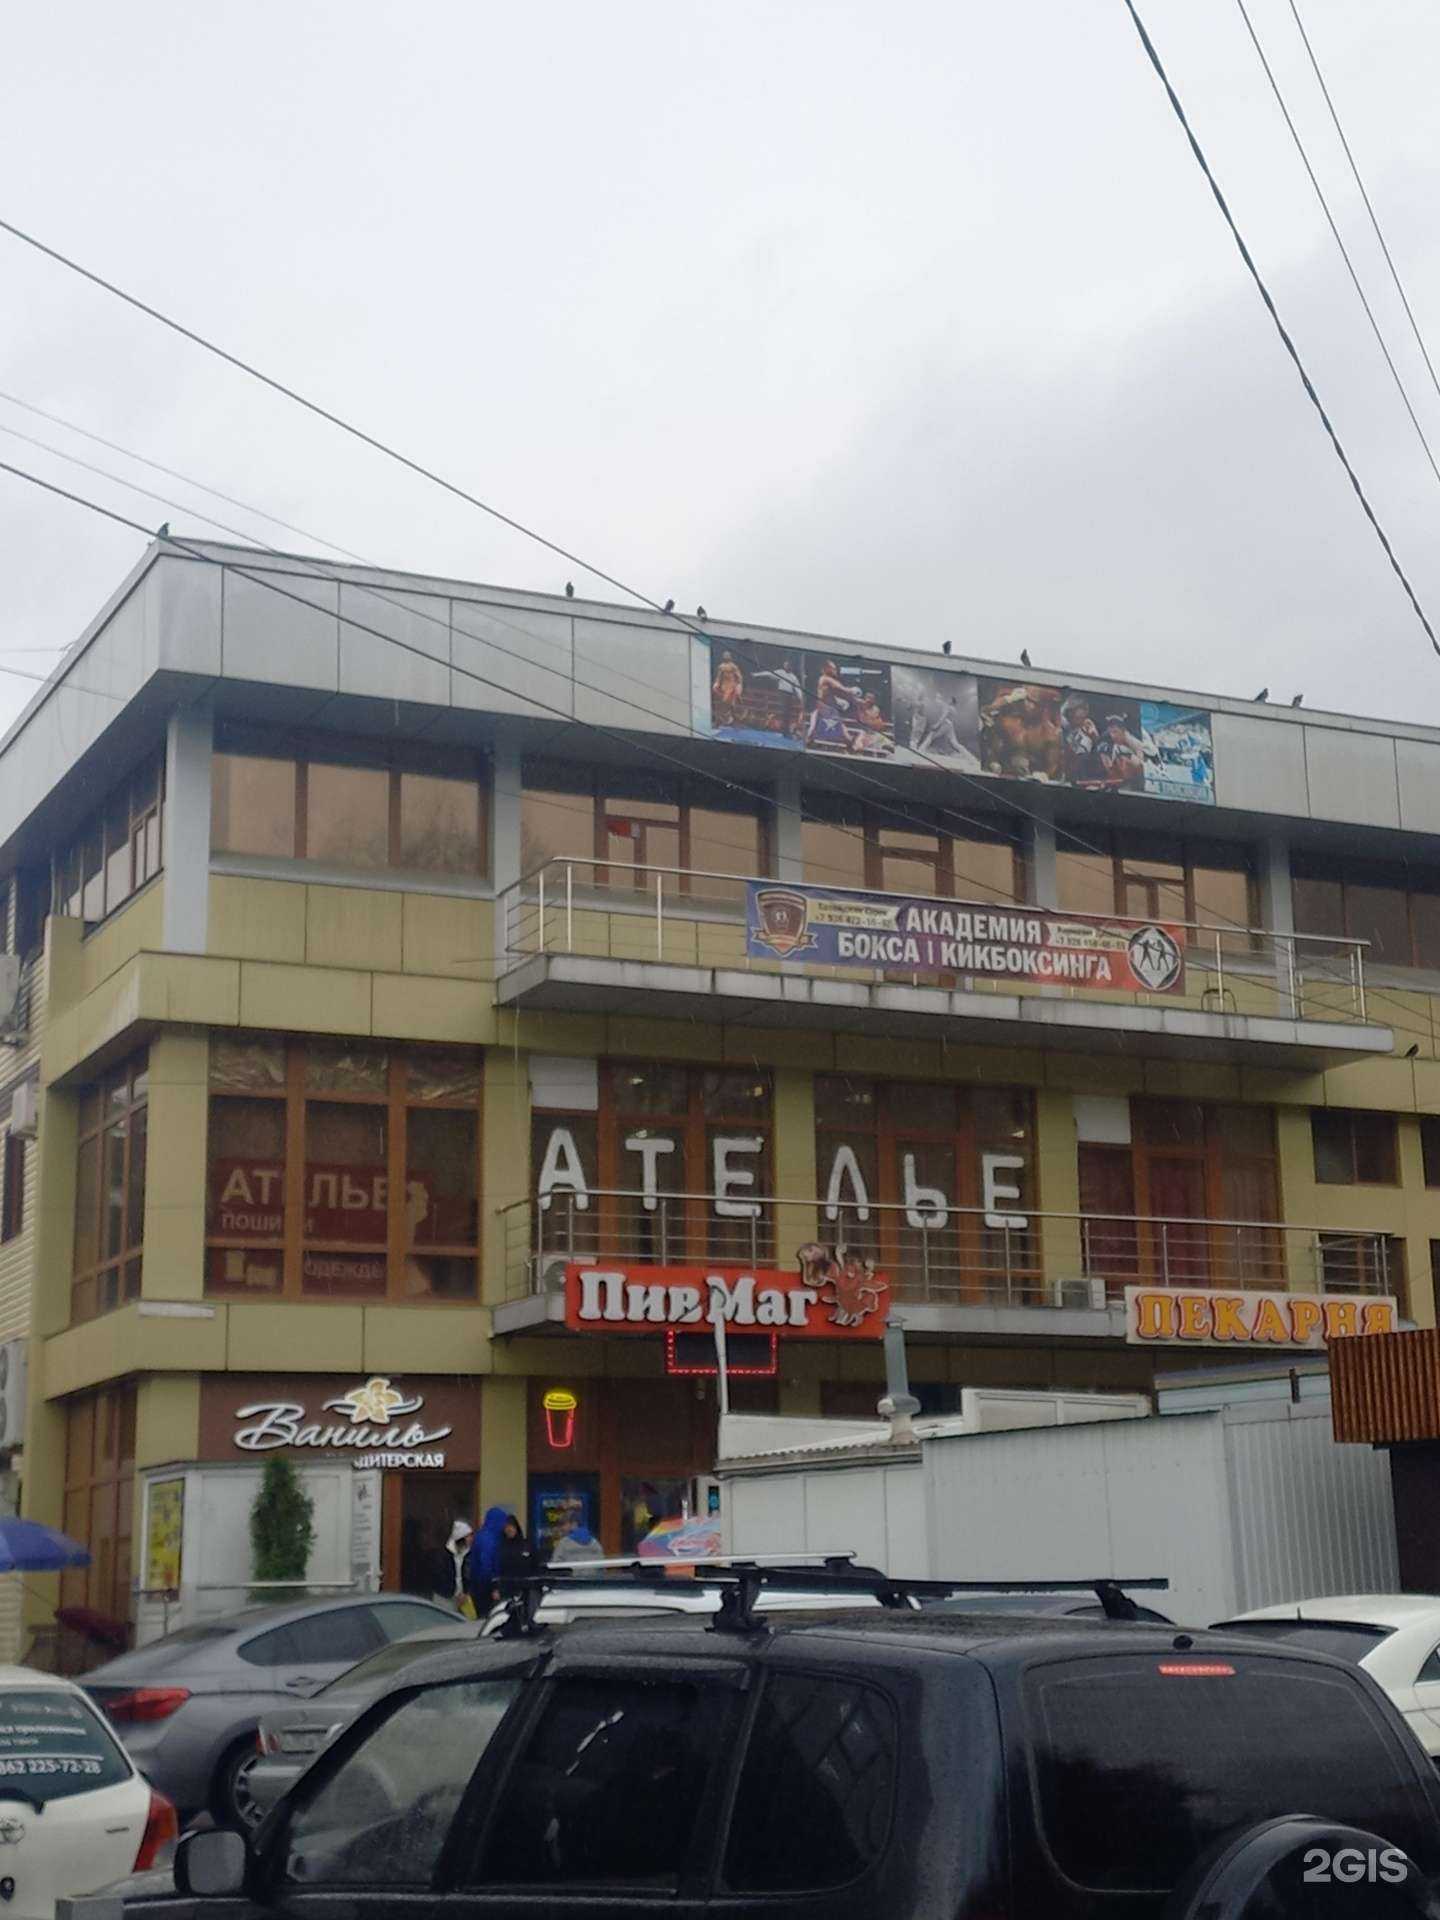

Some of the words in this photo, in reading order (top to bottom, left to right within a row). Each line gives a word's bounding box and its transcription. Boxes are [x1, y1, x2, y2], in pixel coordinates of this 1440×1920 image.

[905, 905, 1043, 945] АКАДЕМИЯ
[838, 931, 922, 963] БОКСА
[941, 942, 1113, 982] КИКБОКСИНГА
[220, 1168, 388, 1211] АТЛЬЕ
[538, 1127, 1030, 1230] АТЕЛЬЕ
[579, 1271, 818, 1328] ПивМаг
[1136, 1293, 1394, 1343] ПЕКАРНЯ
[234, 1403, 452, 1451] Ваниль
